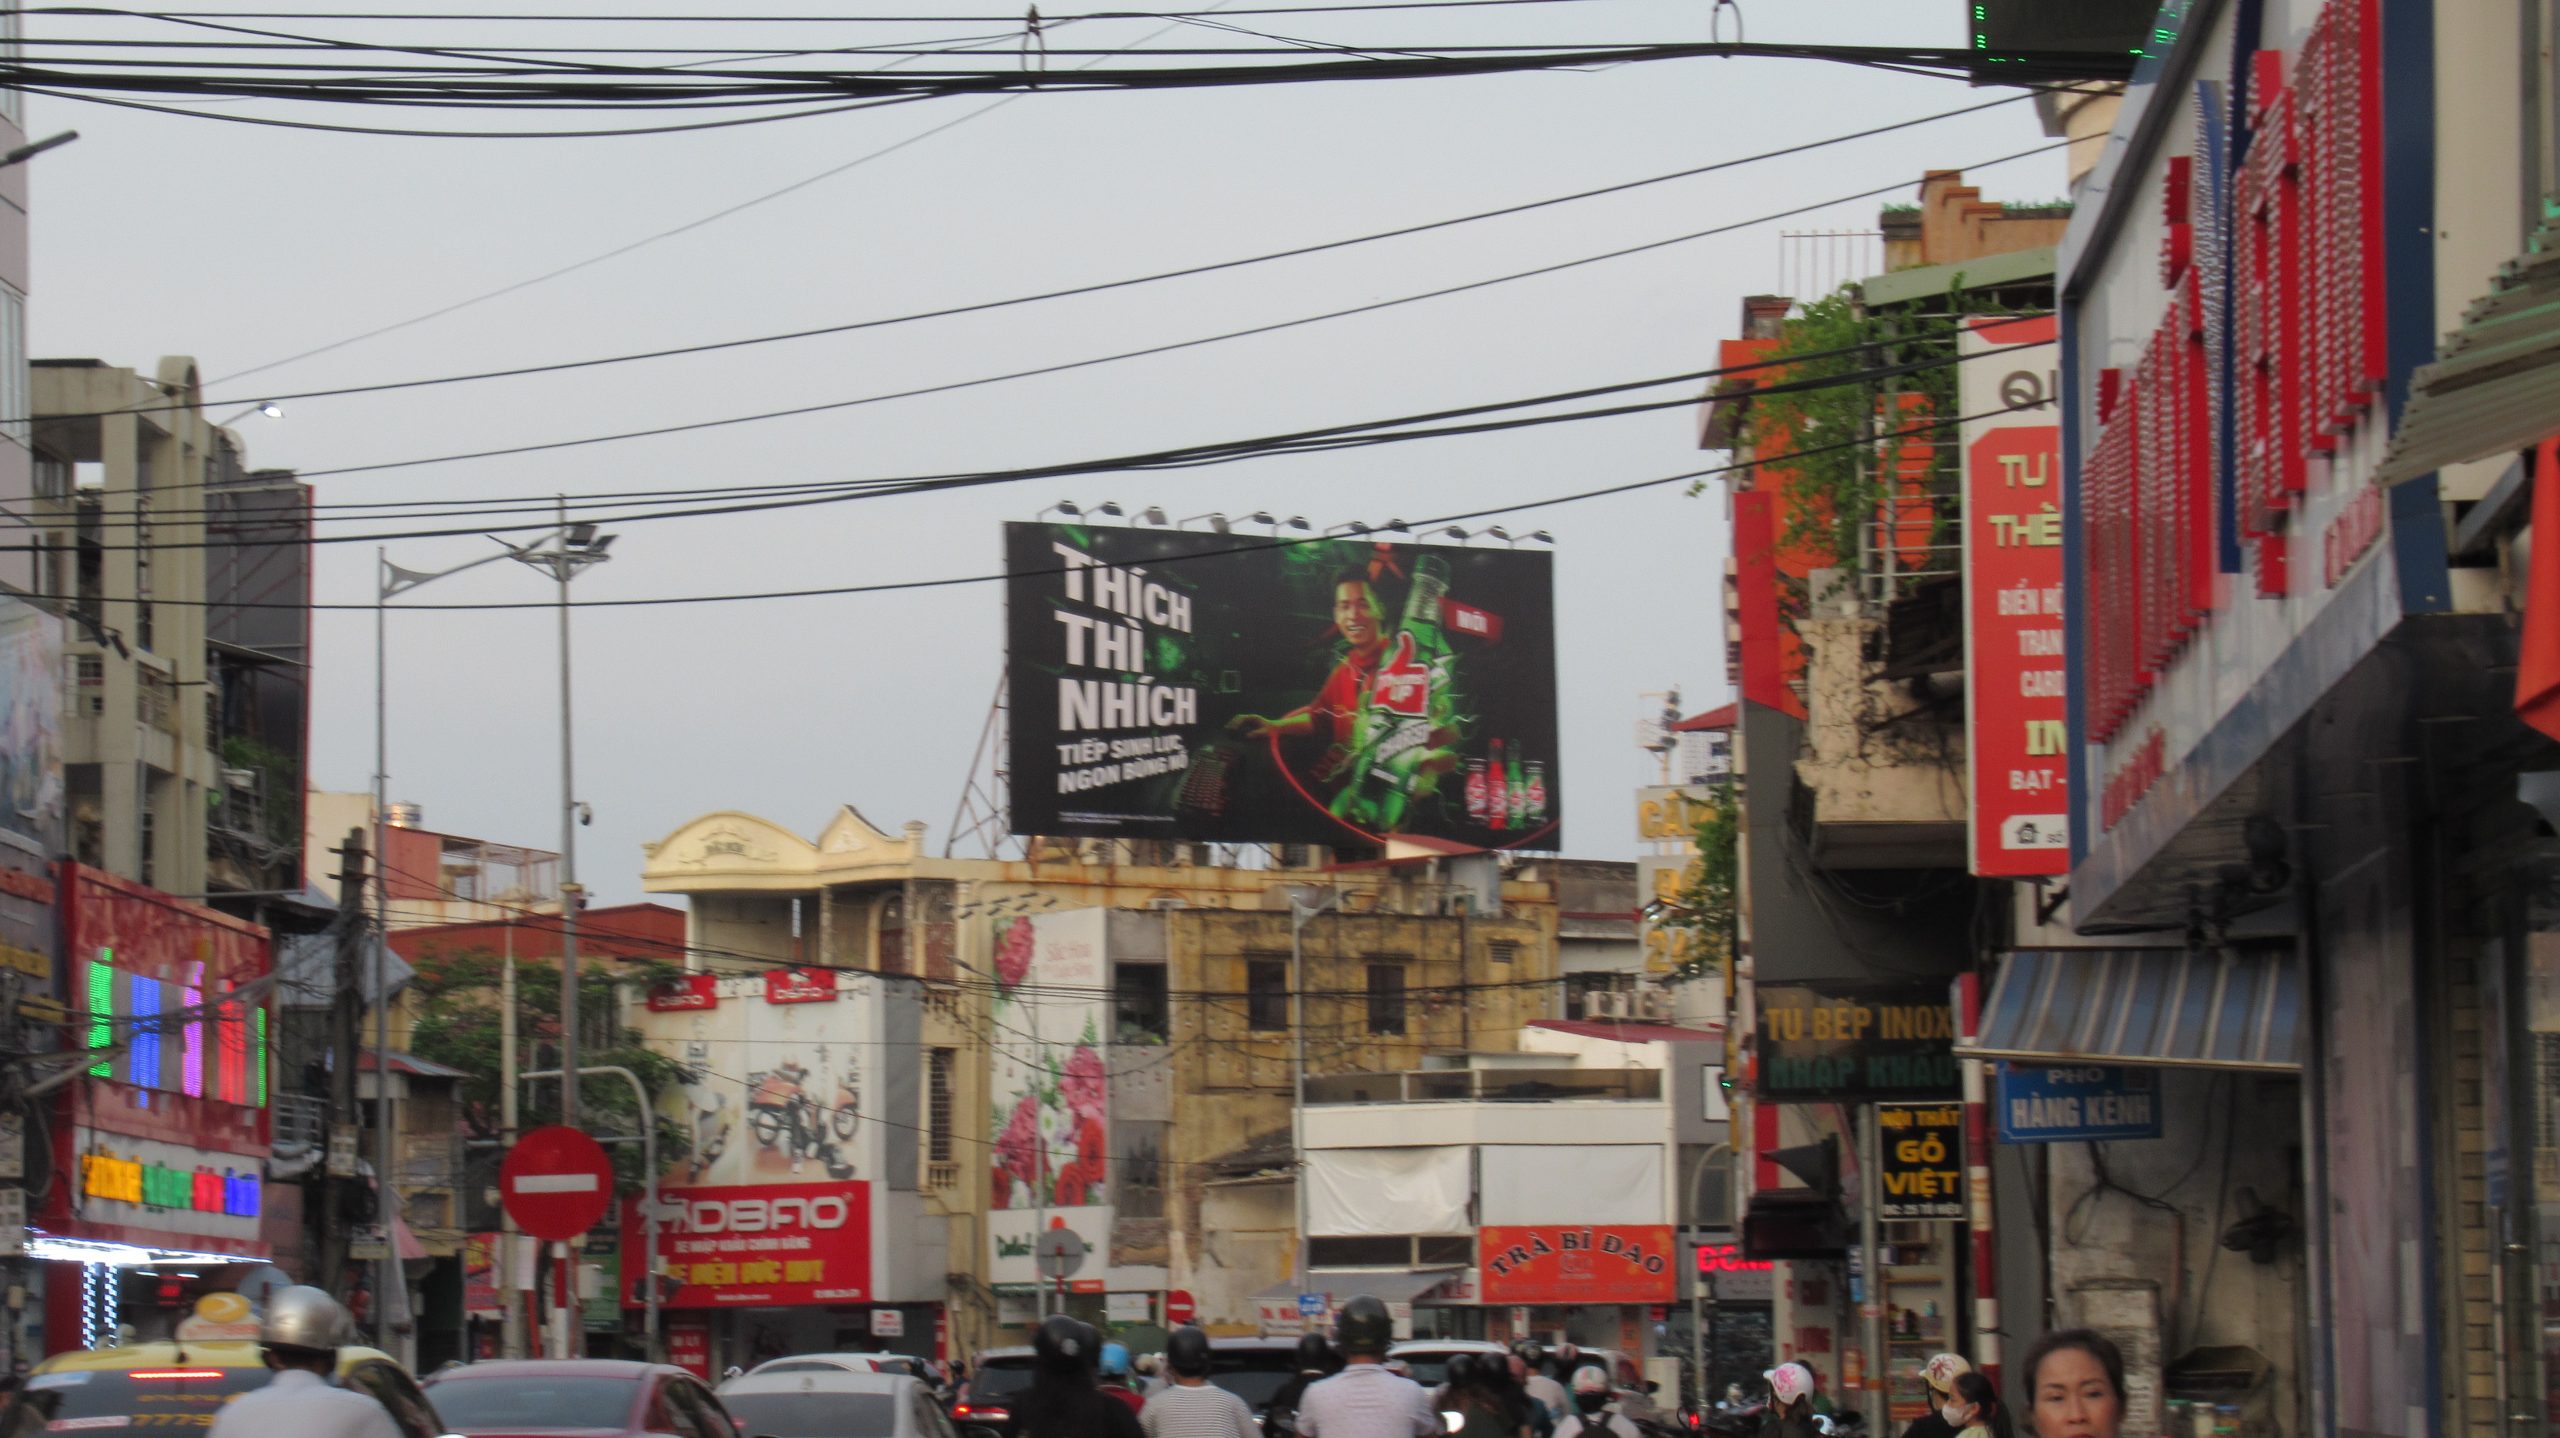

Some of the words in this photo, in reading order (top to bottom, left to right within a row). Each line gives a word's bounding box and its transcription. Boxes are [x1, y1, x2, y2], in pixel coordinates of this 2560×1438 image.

[1053, 541, 1192, 634] THÍCH
[1054, 609, 1144, 673] THÌ
[1058, 675, 1197, 731] NHÍCH
[1056, 738, 1109, 766] TIẾP
[1057, 764, 1121, 795] NGON
[2008, 769, 2054, 796] BẠT
[1880, 1006, 1954, 1040] INOX
[2011, 1091, 2080, 1128] HÀNG
[1883, 1168, 1960, 1199] VIỆT
[1489, 1232, 1553, 1277] TRÀ
